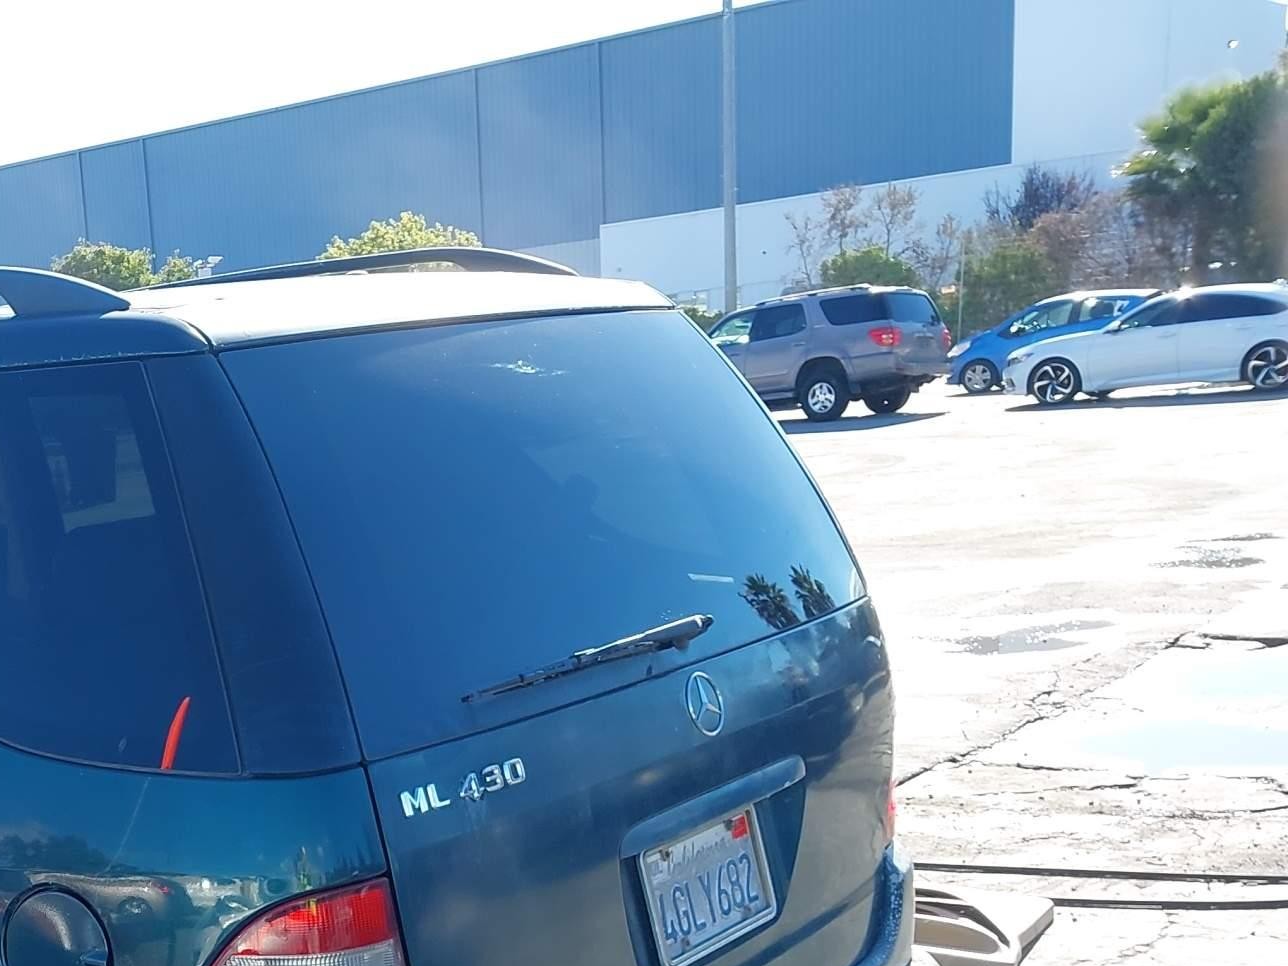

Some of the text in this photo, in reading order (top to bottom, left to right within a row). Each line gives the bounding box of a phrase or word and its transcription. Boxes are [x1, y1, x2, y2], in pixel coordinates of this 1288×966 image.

[400, 757, 526, 817] ML 430
[659, 852, 759, 943] 4GLY682
